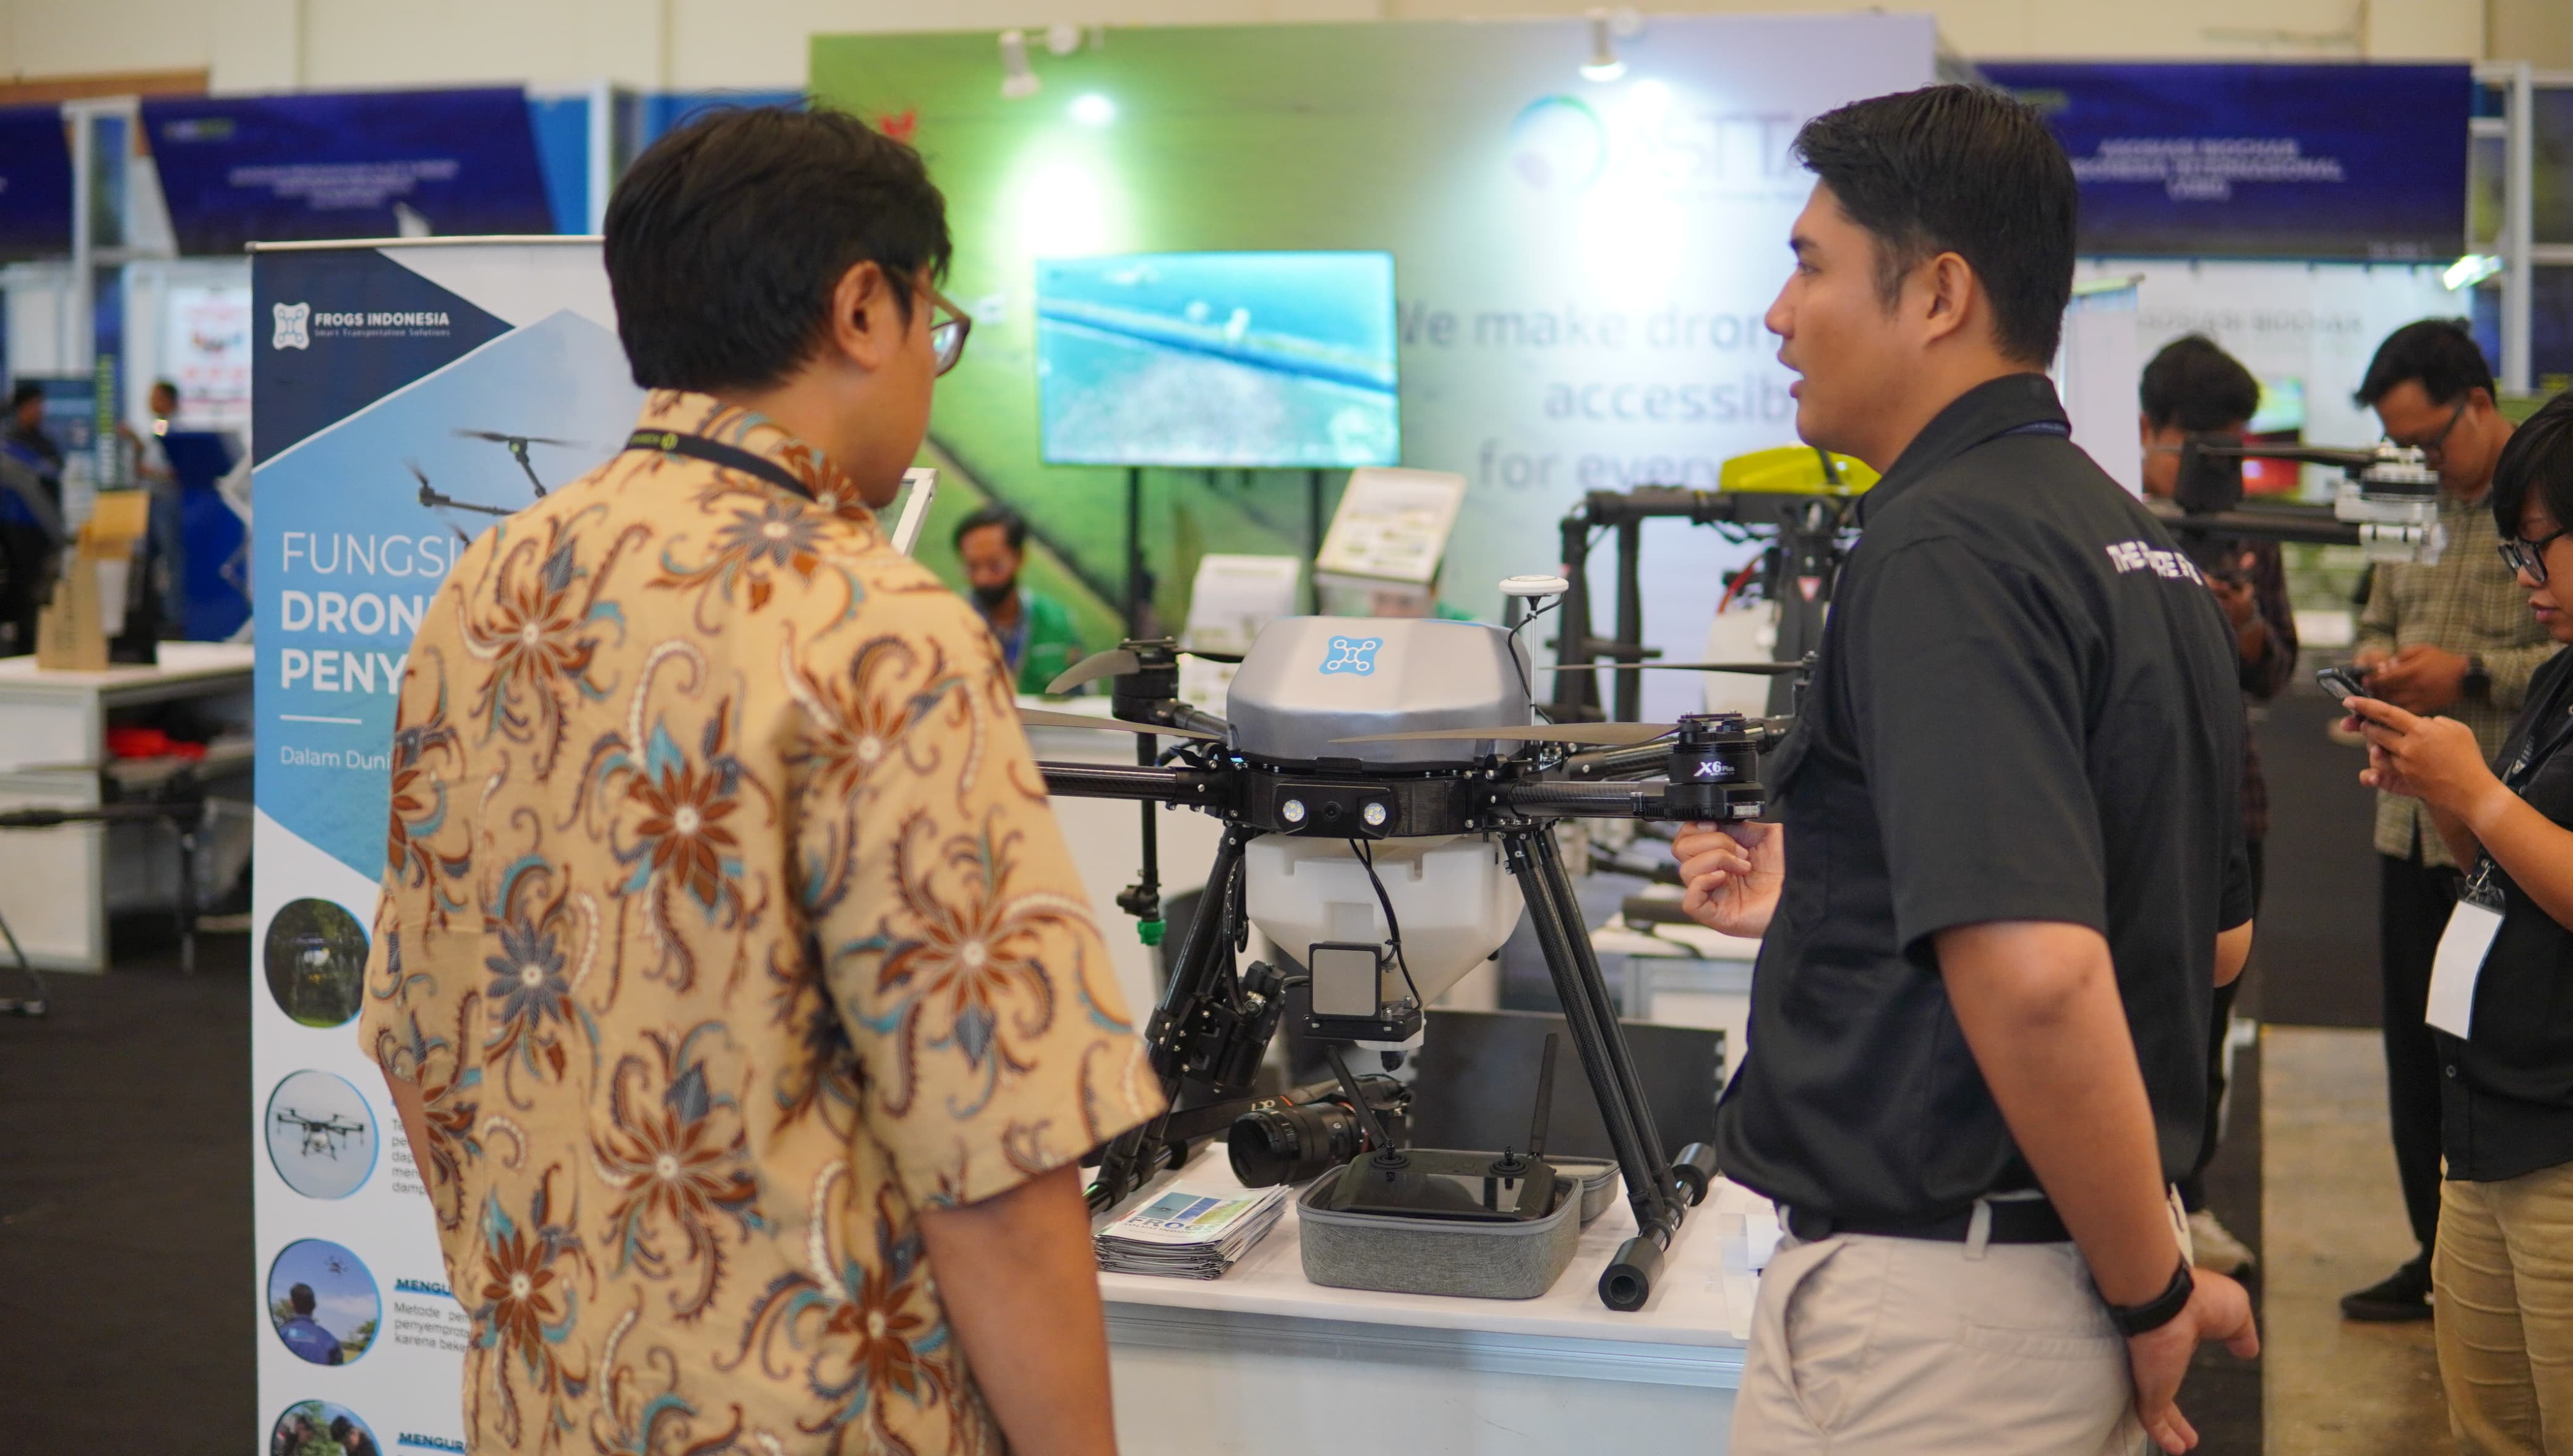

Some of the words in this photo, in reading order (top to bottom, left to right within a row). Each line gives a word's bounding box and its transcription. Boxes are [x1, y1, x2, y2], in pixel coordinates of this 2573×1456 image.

[315, 313, 364, 327] FROGS
[368, 312, 450, 327] INDONESIA
[1475, 302, 1629, 349] make
[343, 328, 405, 338] Transportation
[409, 328, 450, 336] Solutions
[1478, 437, 1558, 490] for
[283, 531, 455, 577] FUNGSI
[281, 589, 437, 636] DRON
[281, 648, 409, 695] PENY
[281, 746, 340, 767] Dalam
[1693, 761, 1721, 777] X6
[395, 1302, 440, 1319] Metode
[395, 1334, 436, 1348] karena
